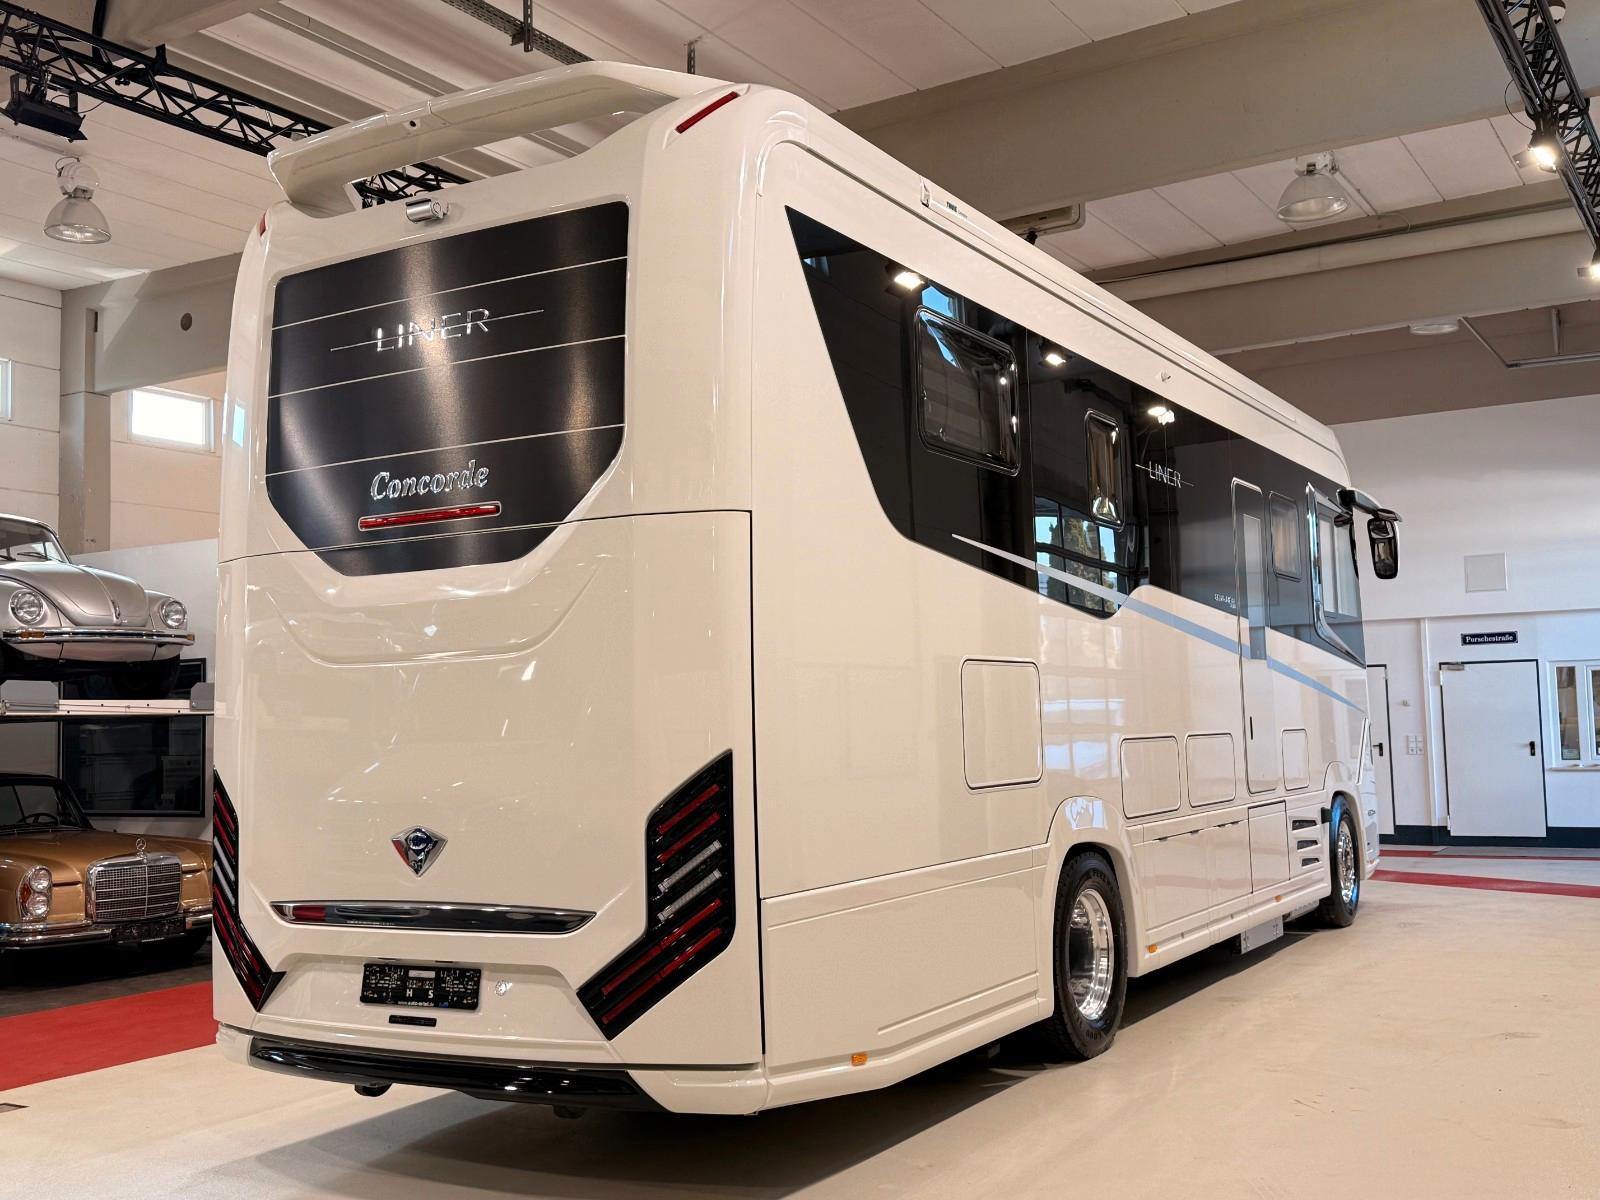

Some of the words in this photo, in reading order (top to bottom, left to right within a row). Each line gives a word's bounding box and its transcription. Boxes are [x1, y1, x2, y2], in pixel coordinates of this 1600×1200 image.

[376, 308, 490, 352] LINER
[370, 459, 490, 500] Concorde
[1148, 461, 1182, 488] LINER
